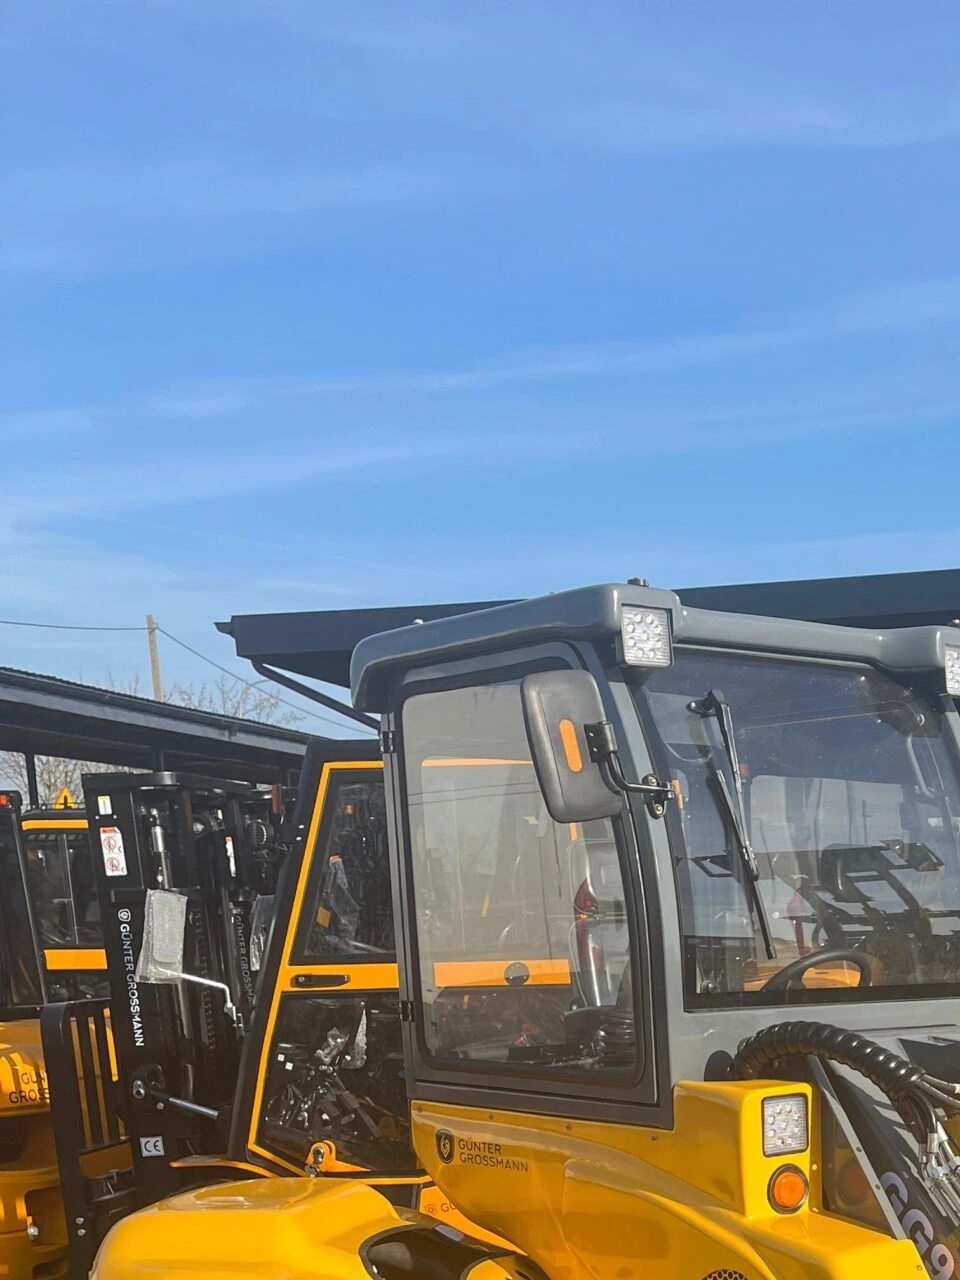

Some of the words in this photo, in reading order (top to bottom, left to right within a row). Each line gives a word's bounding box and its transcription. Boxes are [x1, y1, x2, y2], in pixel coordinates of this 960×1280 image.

[120, 923, 135, 972] GÜNTER
[126, 973, 145, 1047] GROSSMANN
[144, 1139, 161, 1153] CE
[457, 1136, 502, 1156] GÜNTER
[459, 1151, 528, 1173] GROSSMANN
